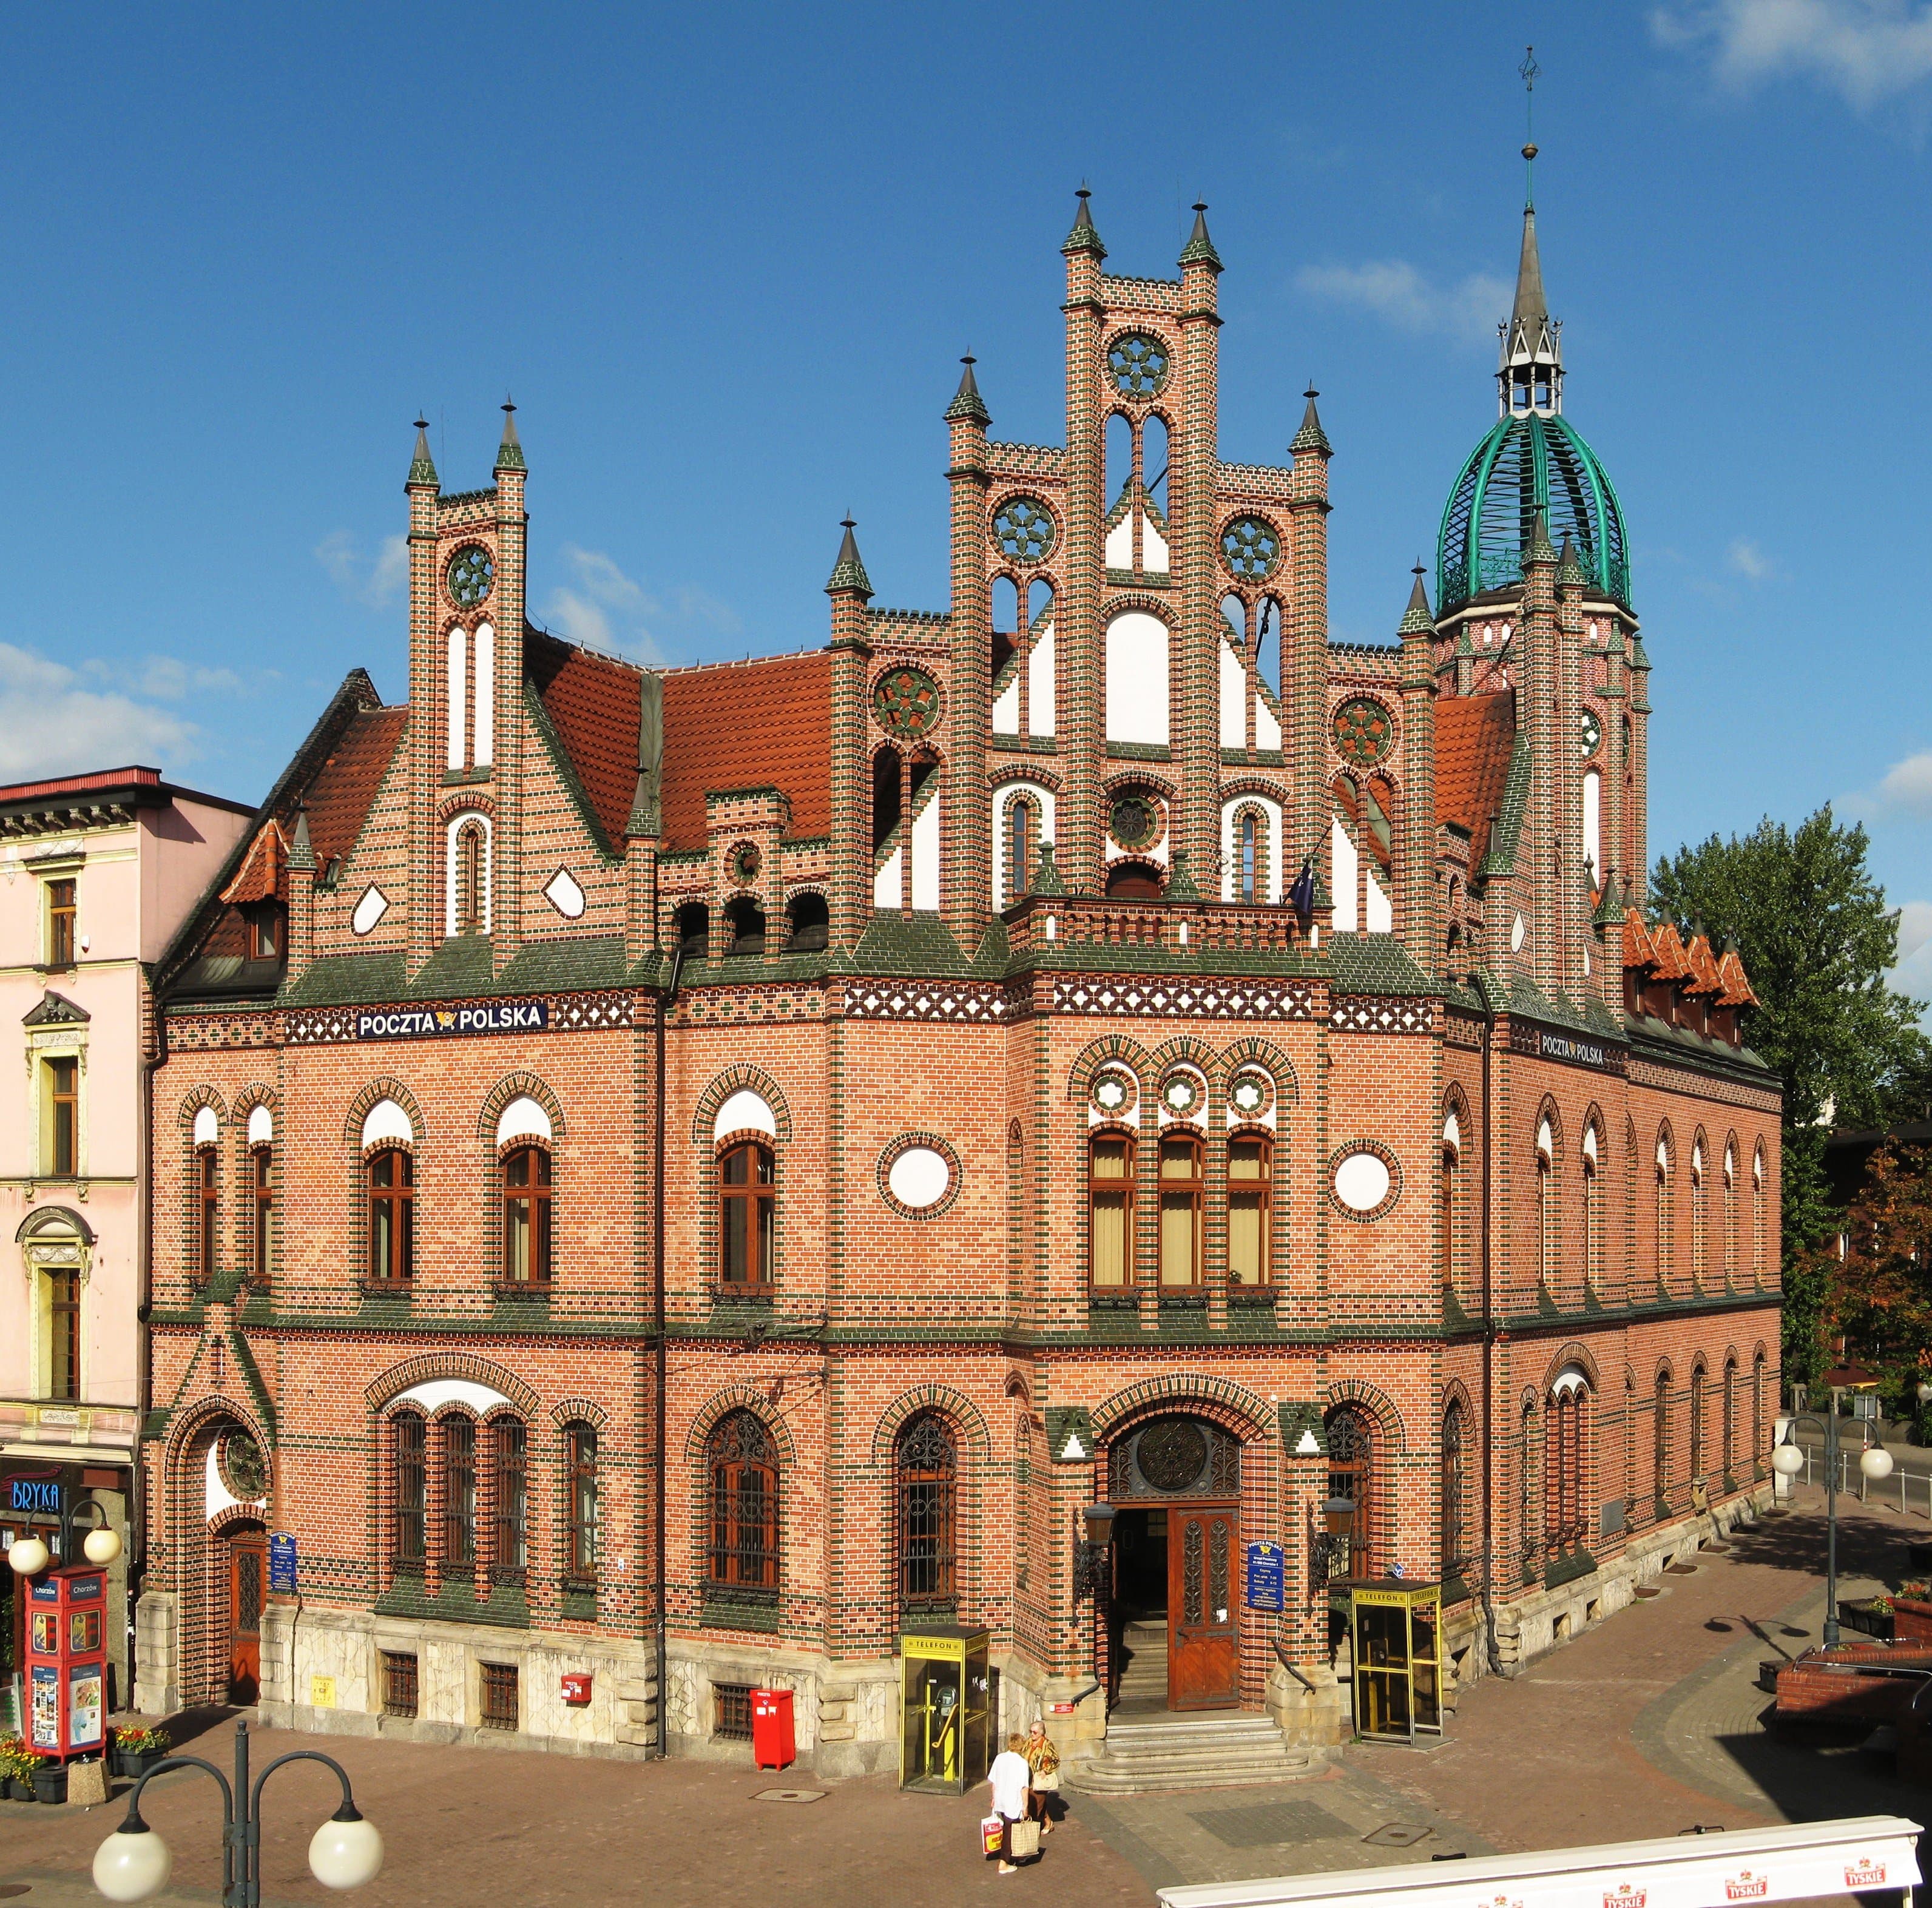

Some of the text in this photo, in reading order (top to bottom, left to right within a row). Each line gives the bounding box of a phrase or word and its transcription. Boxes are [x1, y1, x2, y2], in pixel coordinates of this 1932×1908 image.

[360, 1006, 541, 1035] POCZTA POLSKA
[1542, 1035, 1603, 1065] POCZTA POLSKA
[13, 1482, 59, 1511] BRYKA
[73, 1584, 97, 1594] Chorzów
[1415, 1590, 1433, 1600] TELEFON
[1848, 1870, 1883, 1885] TYSKIE
[1729, 1882, 1765, 1898] TYSKIE
[1606, 1896, 1643, 1908] TYSKIE
